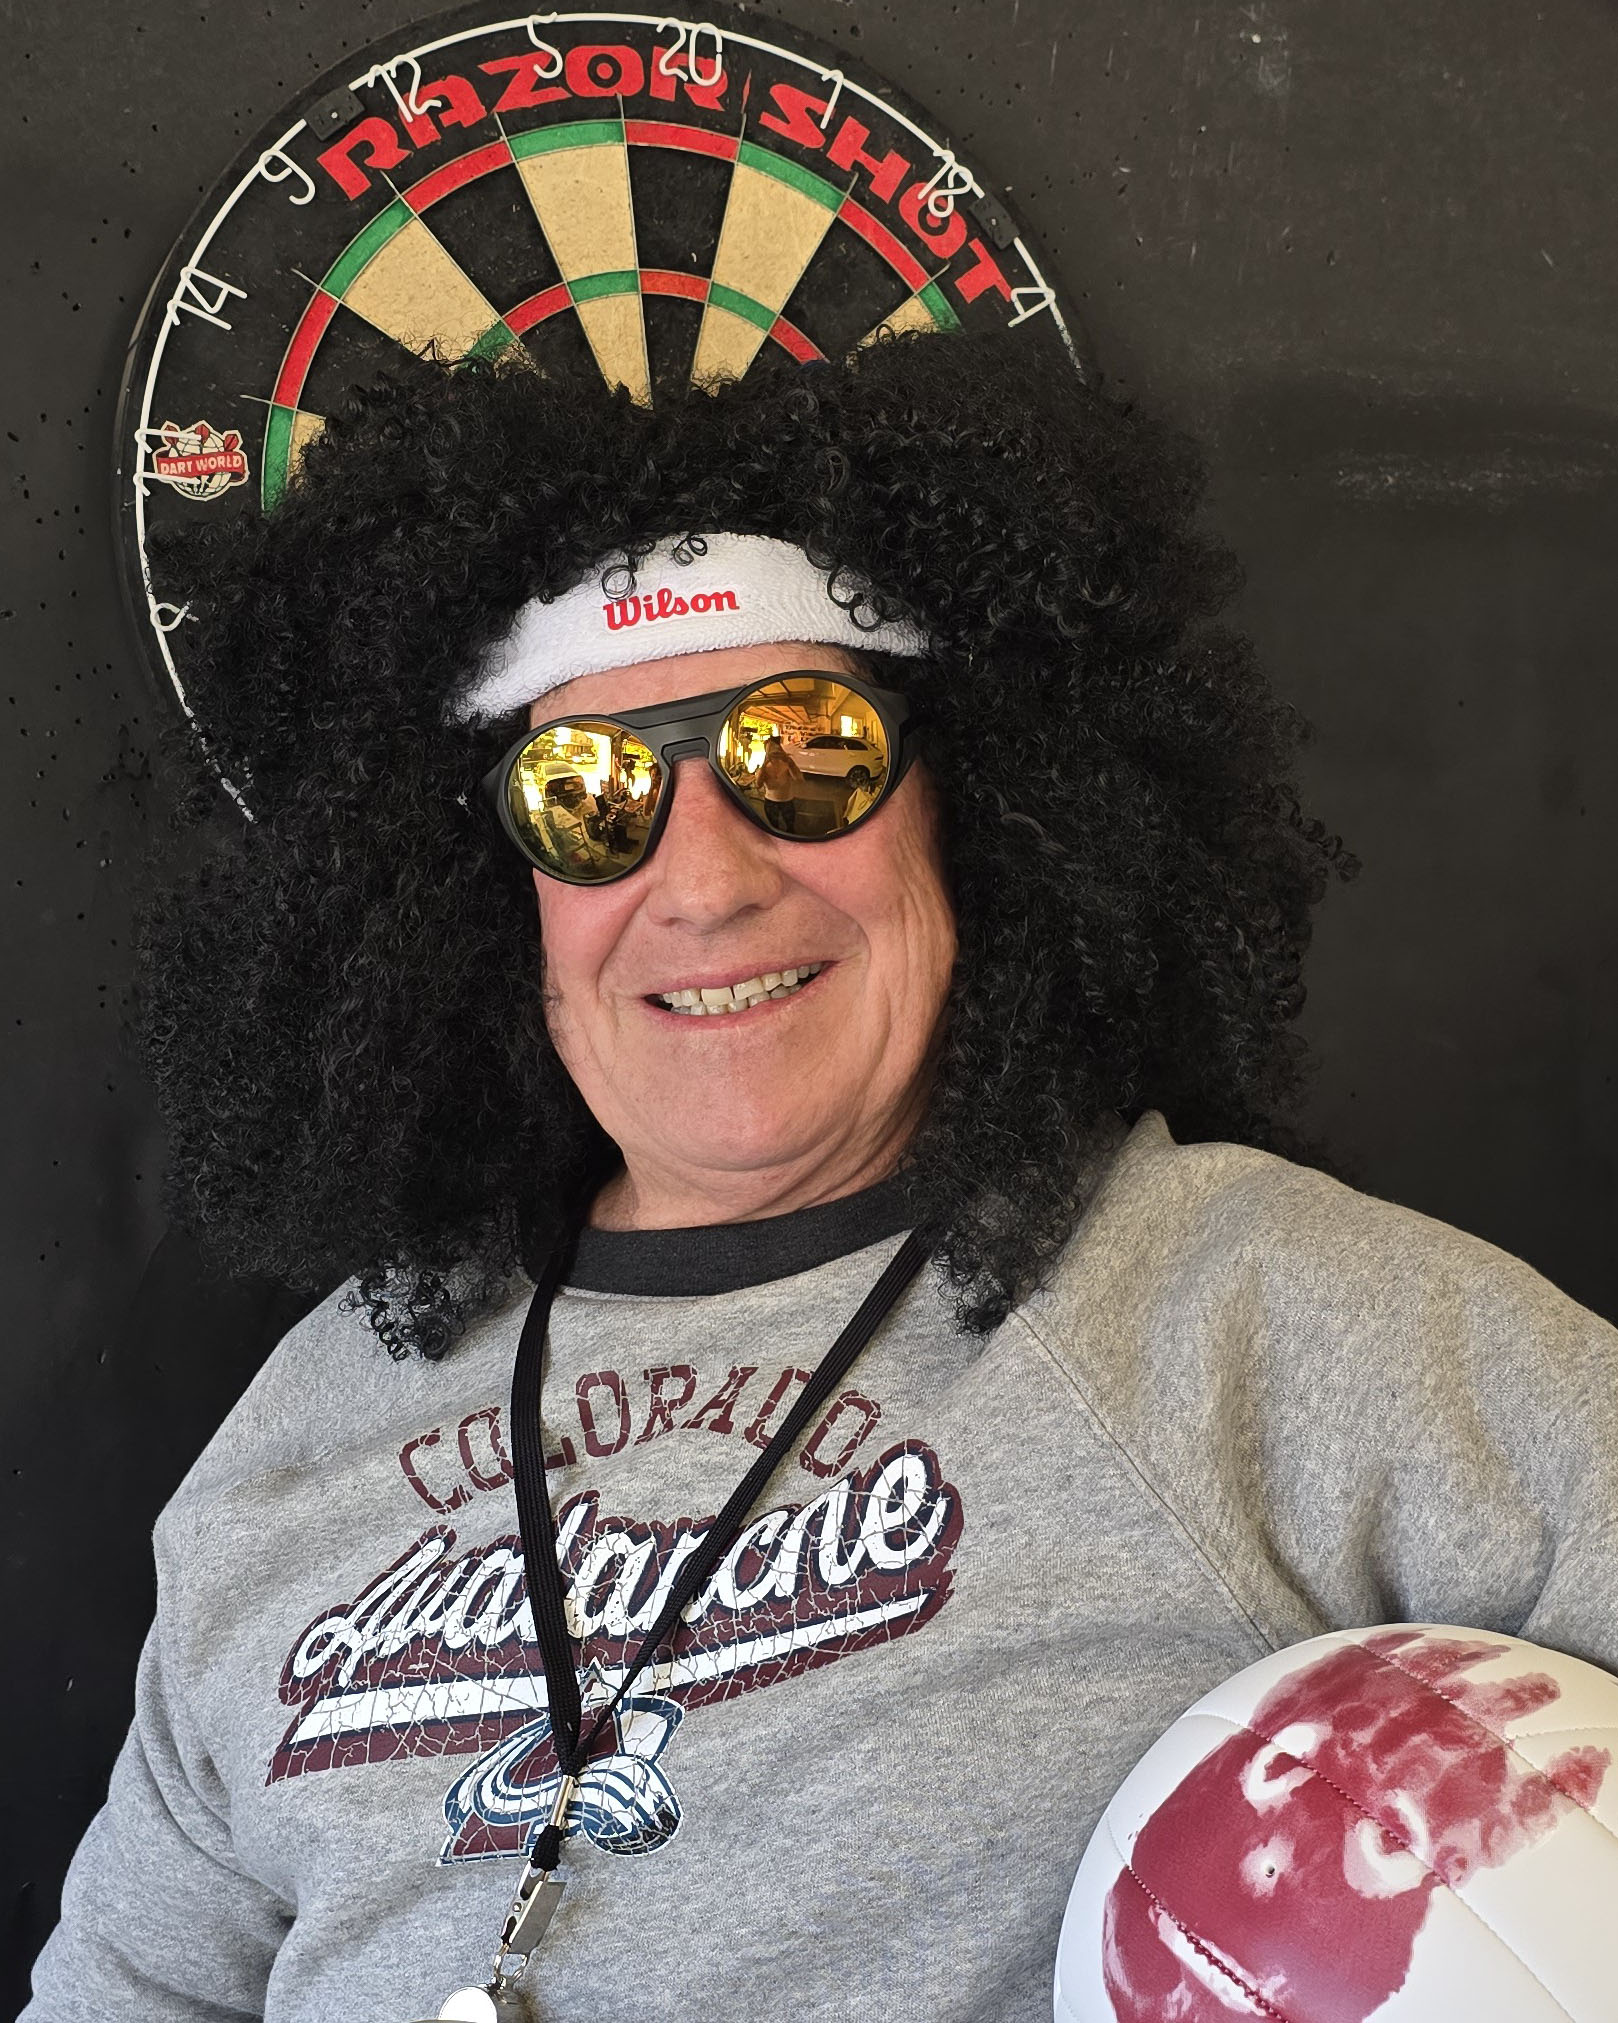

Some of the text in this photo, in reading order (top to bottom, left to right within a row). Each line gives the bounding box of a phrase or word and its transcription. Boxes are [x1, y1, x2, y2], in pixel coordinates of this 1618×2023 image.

[527, 12, 563, 79] 5
[656, 17, 723, 87] 20
[367, 55, 441, 122] 12
[821, 69, 844, 129] 1
[259, 149, 316, 205] 9
[316, 45, 1013, 304] RAZOR SHOT
[918, 148, 973, 218] 18
[167, 266, 248, 330] 14
[1008, 287, 1056, 328] 4
[133, 428, 202, 497] 11
[160, 455, 242, 475] DART WORLD
[603, 588, 740, 630] Wilson
